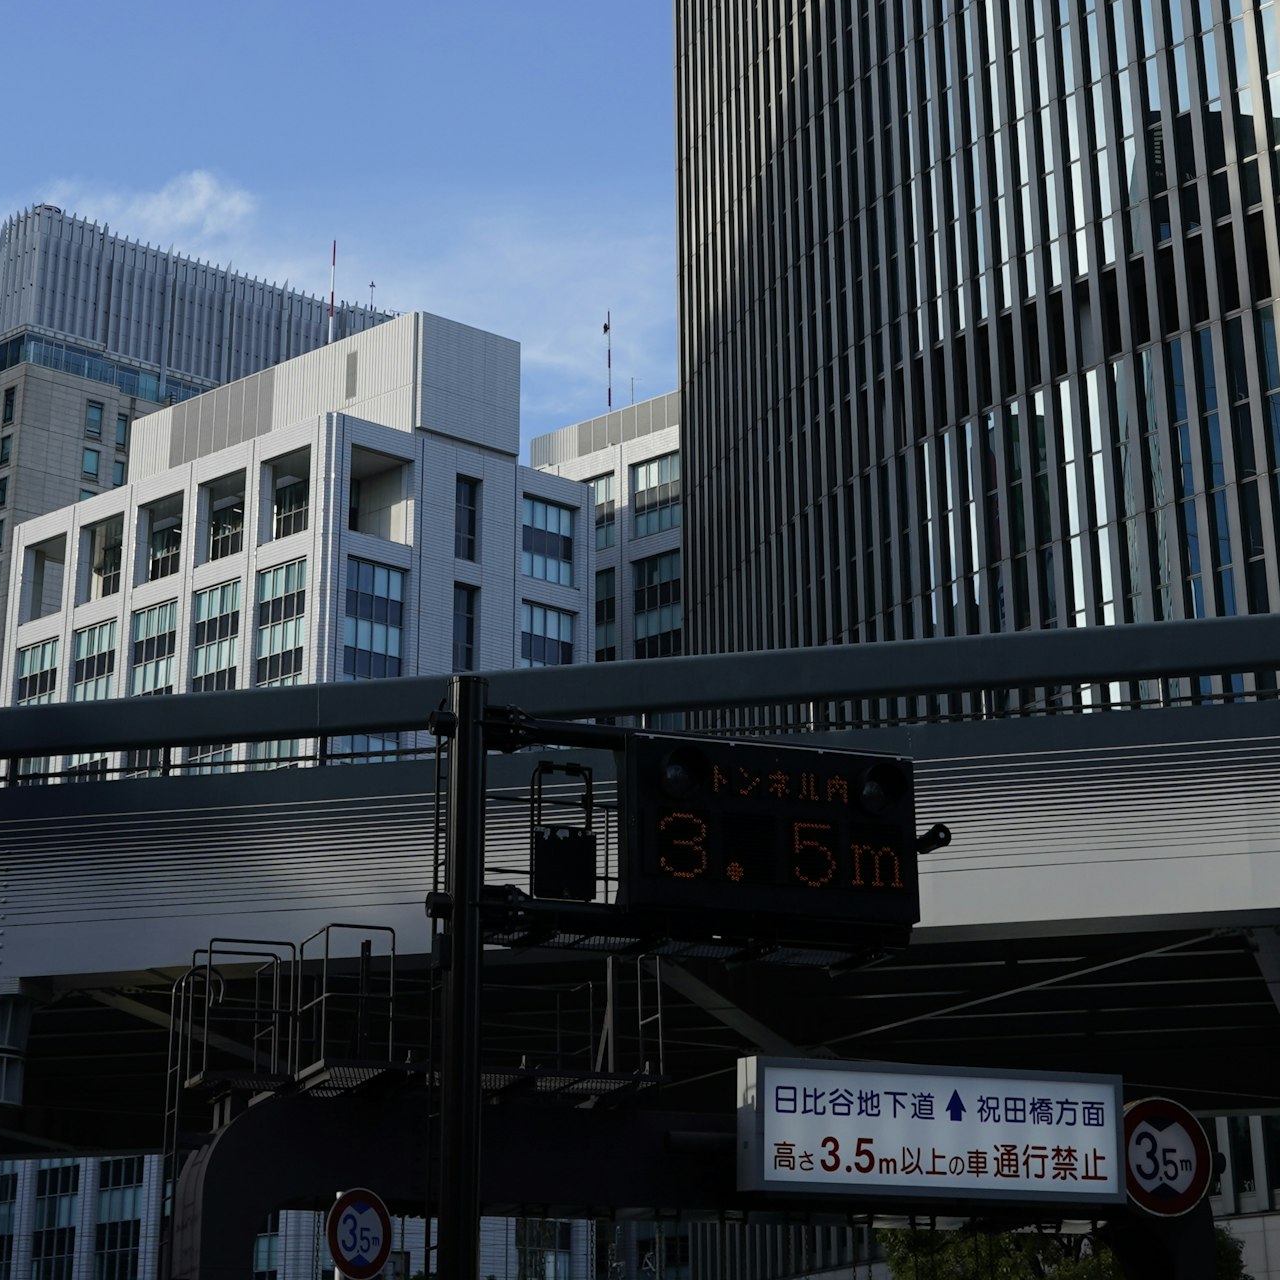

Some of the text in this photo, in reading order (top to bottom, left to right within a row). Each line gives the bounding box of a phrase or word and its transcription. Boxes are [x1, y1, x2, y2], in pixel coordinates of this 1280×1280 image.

[712, 763, 849, 806] トンネル内
[774, 1085, 1106, 1127] 日比谷地下道 祝田橋方面
[1135, 1131, 1192, 1182] 3.5m
[342, 1214, 380, 1253] 3.5m
